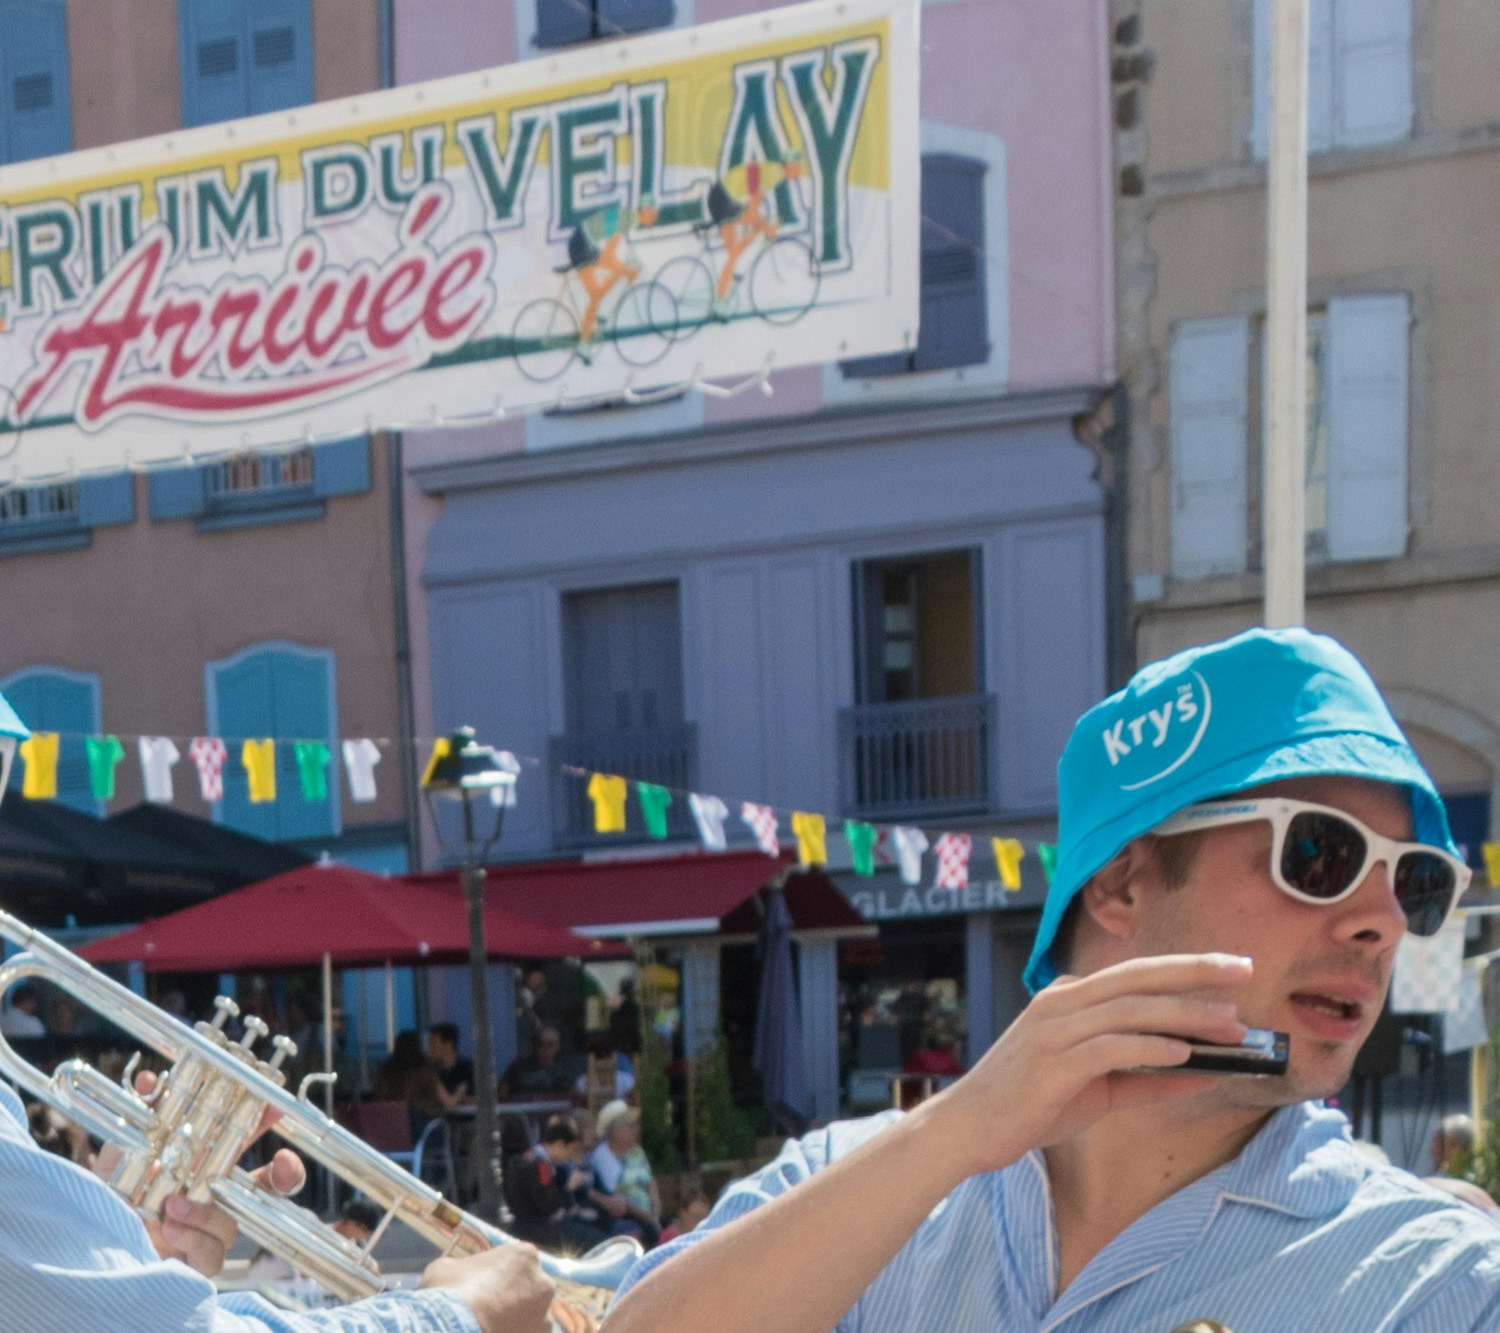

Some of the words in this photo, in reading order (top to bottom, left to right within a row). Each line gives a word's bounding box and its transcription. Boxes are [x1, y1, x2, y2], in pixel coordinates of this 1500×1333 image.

[306, 133, 440, 220] DU
[462, 45, 872, 264] VELAY
[15, 193, 486, 422] Arrivée
[1102, 691, 1199, 767] Krys
[851, 880, 1008, 920] GLACIER
